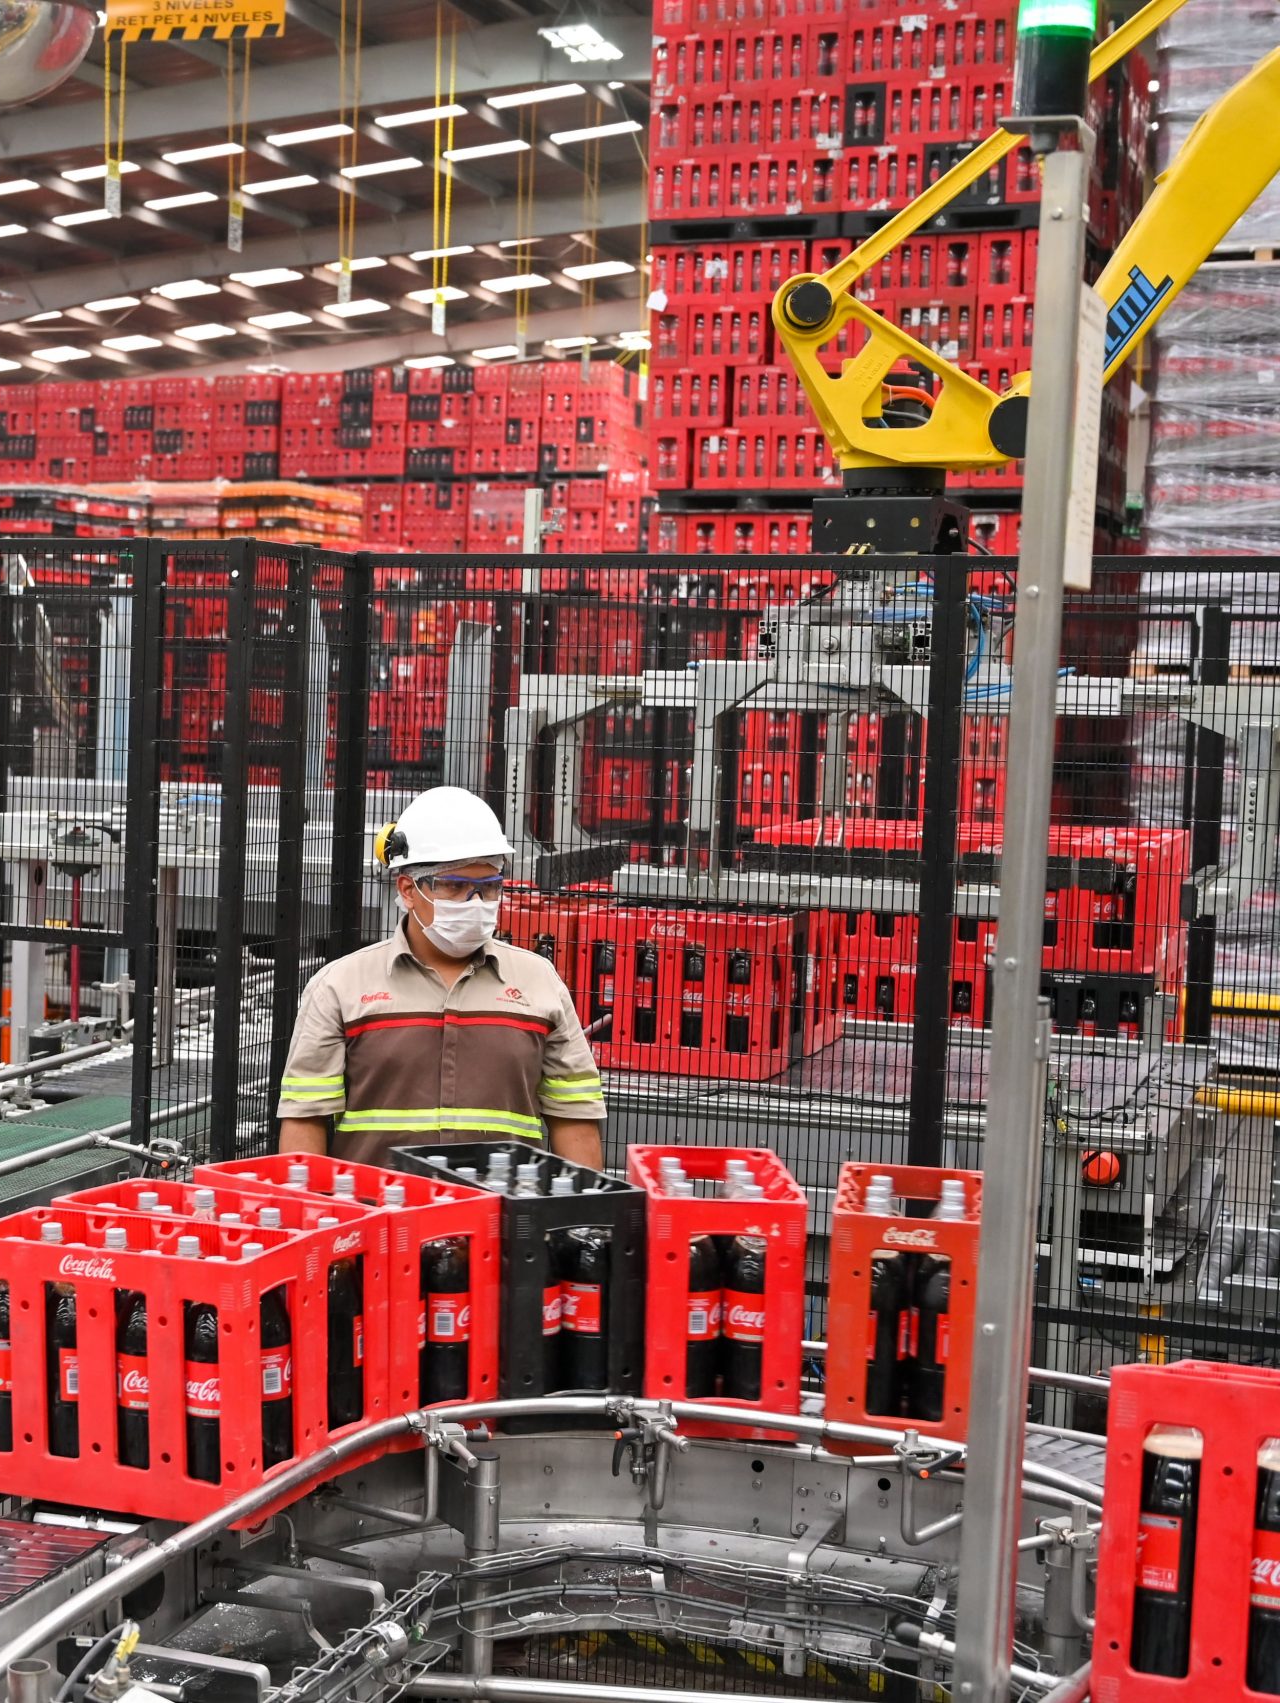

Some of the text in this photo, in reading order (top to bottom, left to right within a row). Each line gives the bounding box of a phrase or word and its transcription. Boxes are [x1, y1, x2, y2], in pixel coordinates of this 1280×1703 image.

[153, 0, 234, 11] 3 NIVELES
[116, 11, 273, 26] RET PET 4 NIVELES
[360, 991, 392, 1004] Coca-Cola
[59, 1254, 116, 1280] Coca-Cola
